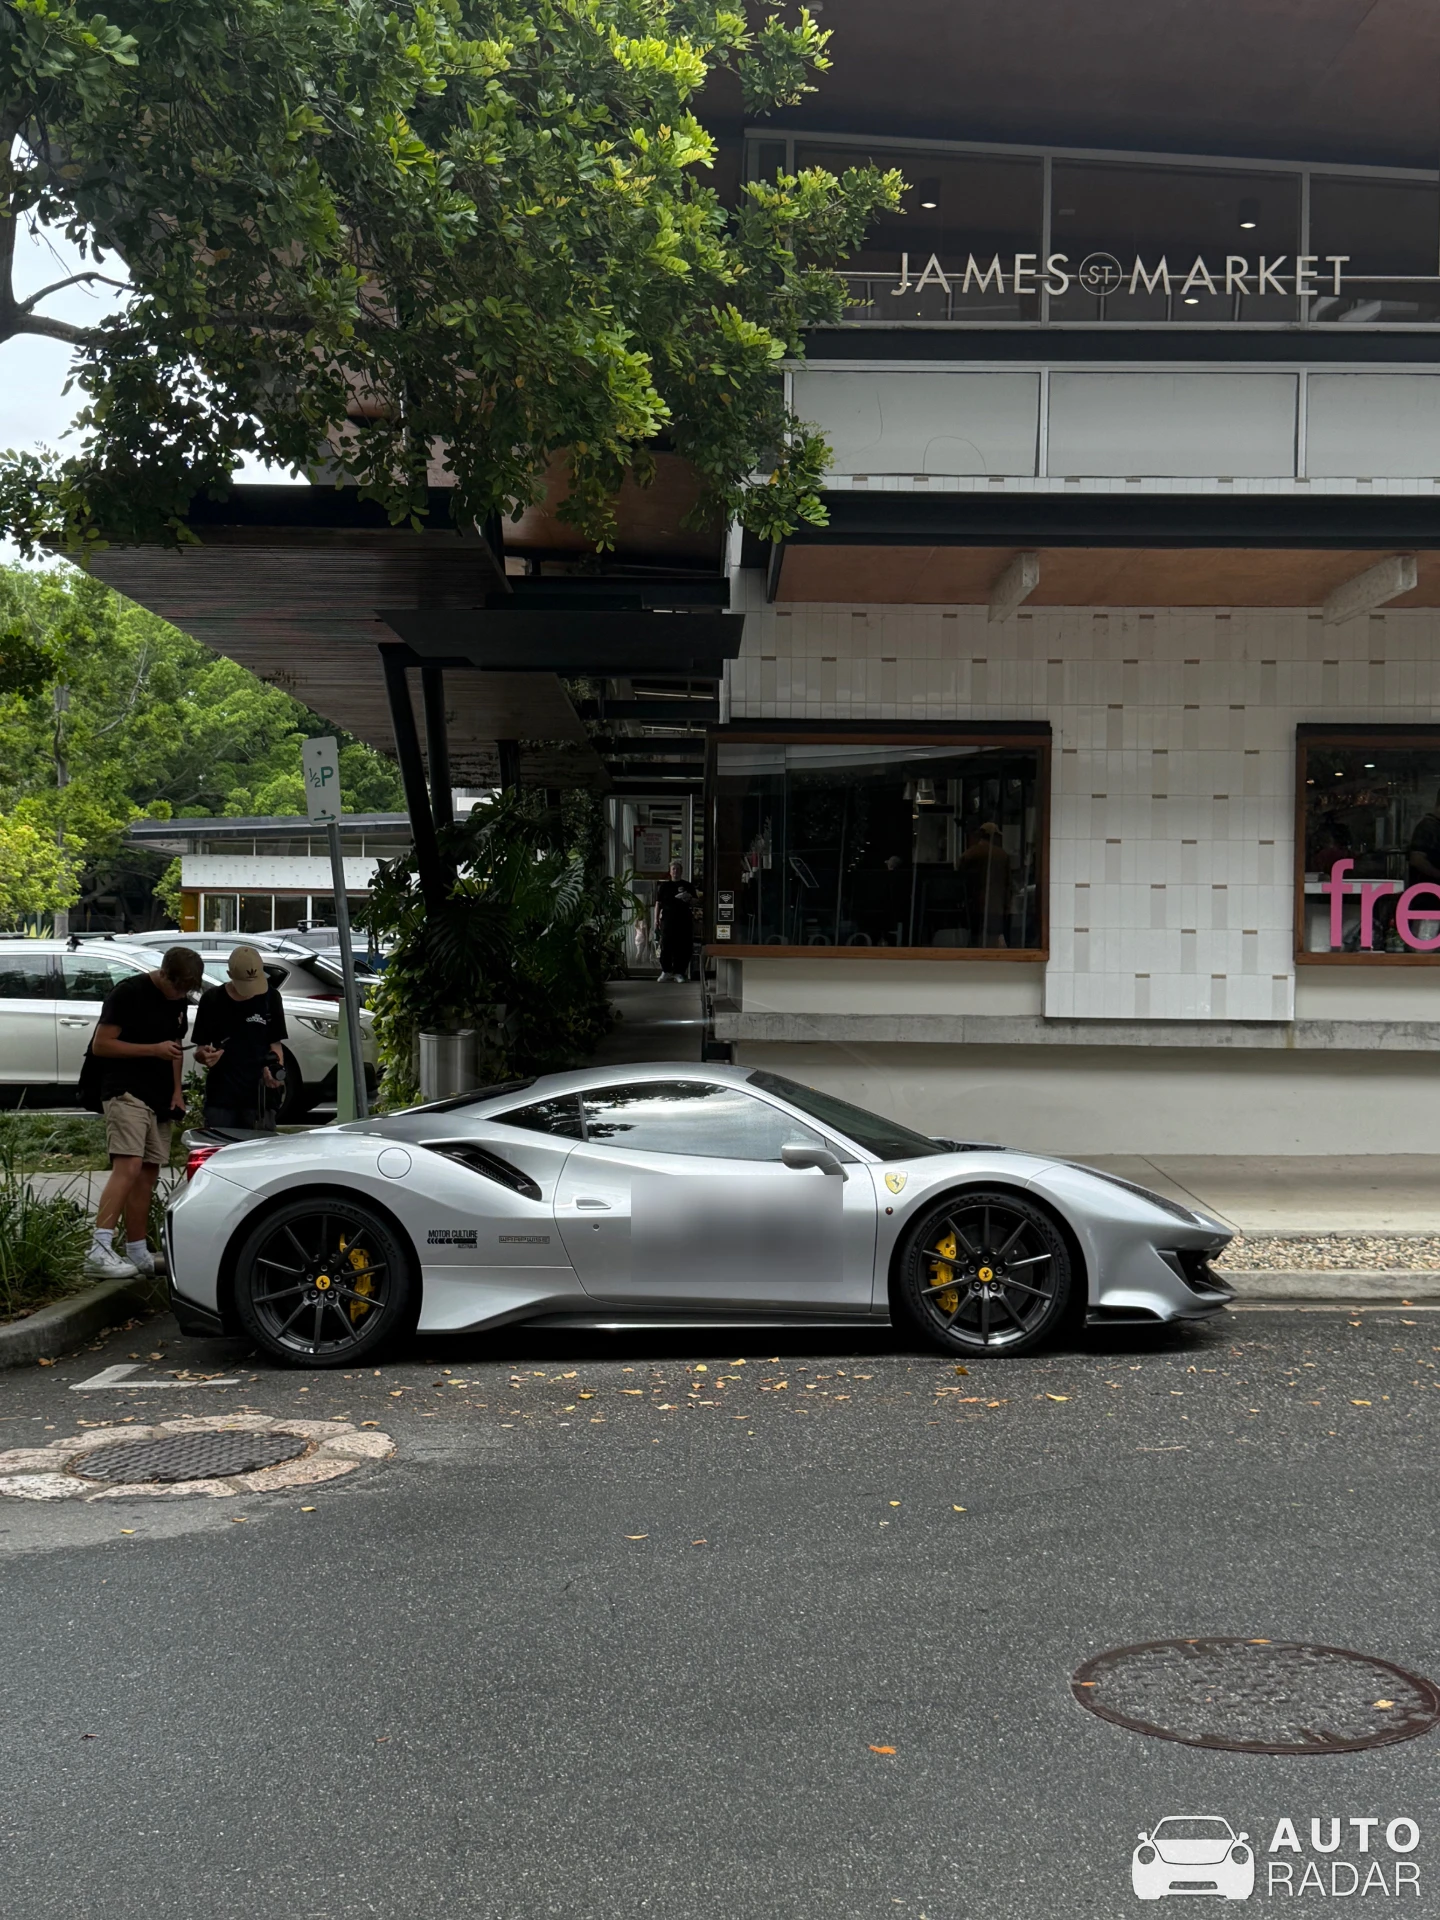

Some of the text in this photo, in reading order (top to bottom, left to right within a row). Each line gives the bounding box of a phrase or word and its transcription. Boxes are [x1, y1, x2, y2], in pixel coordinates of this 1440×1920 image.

[891, 252, 1351, 297] JAMES ST MARKET
[428, 1229, 478, 1238] MOTOR CULTURE
